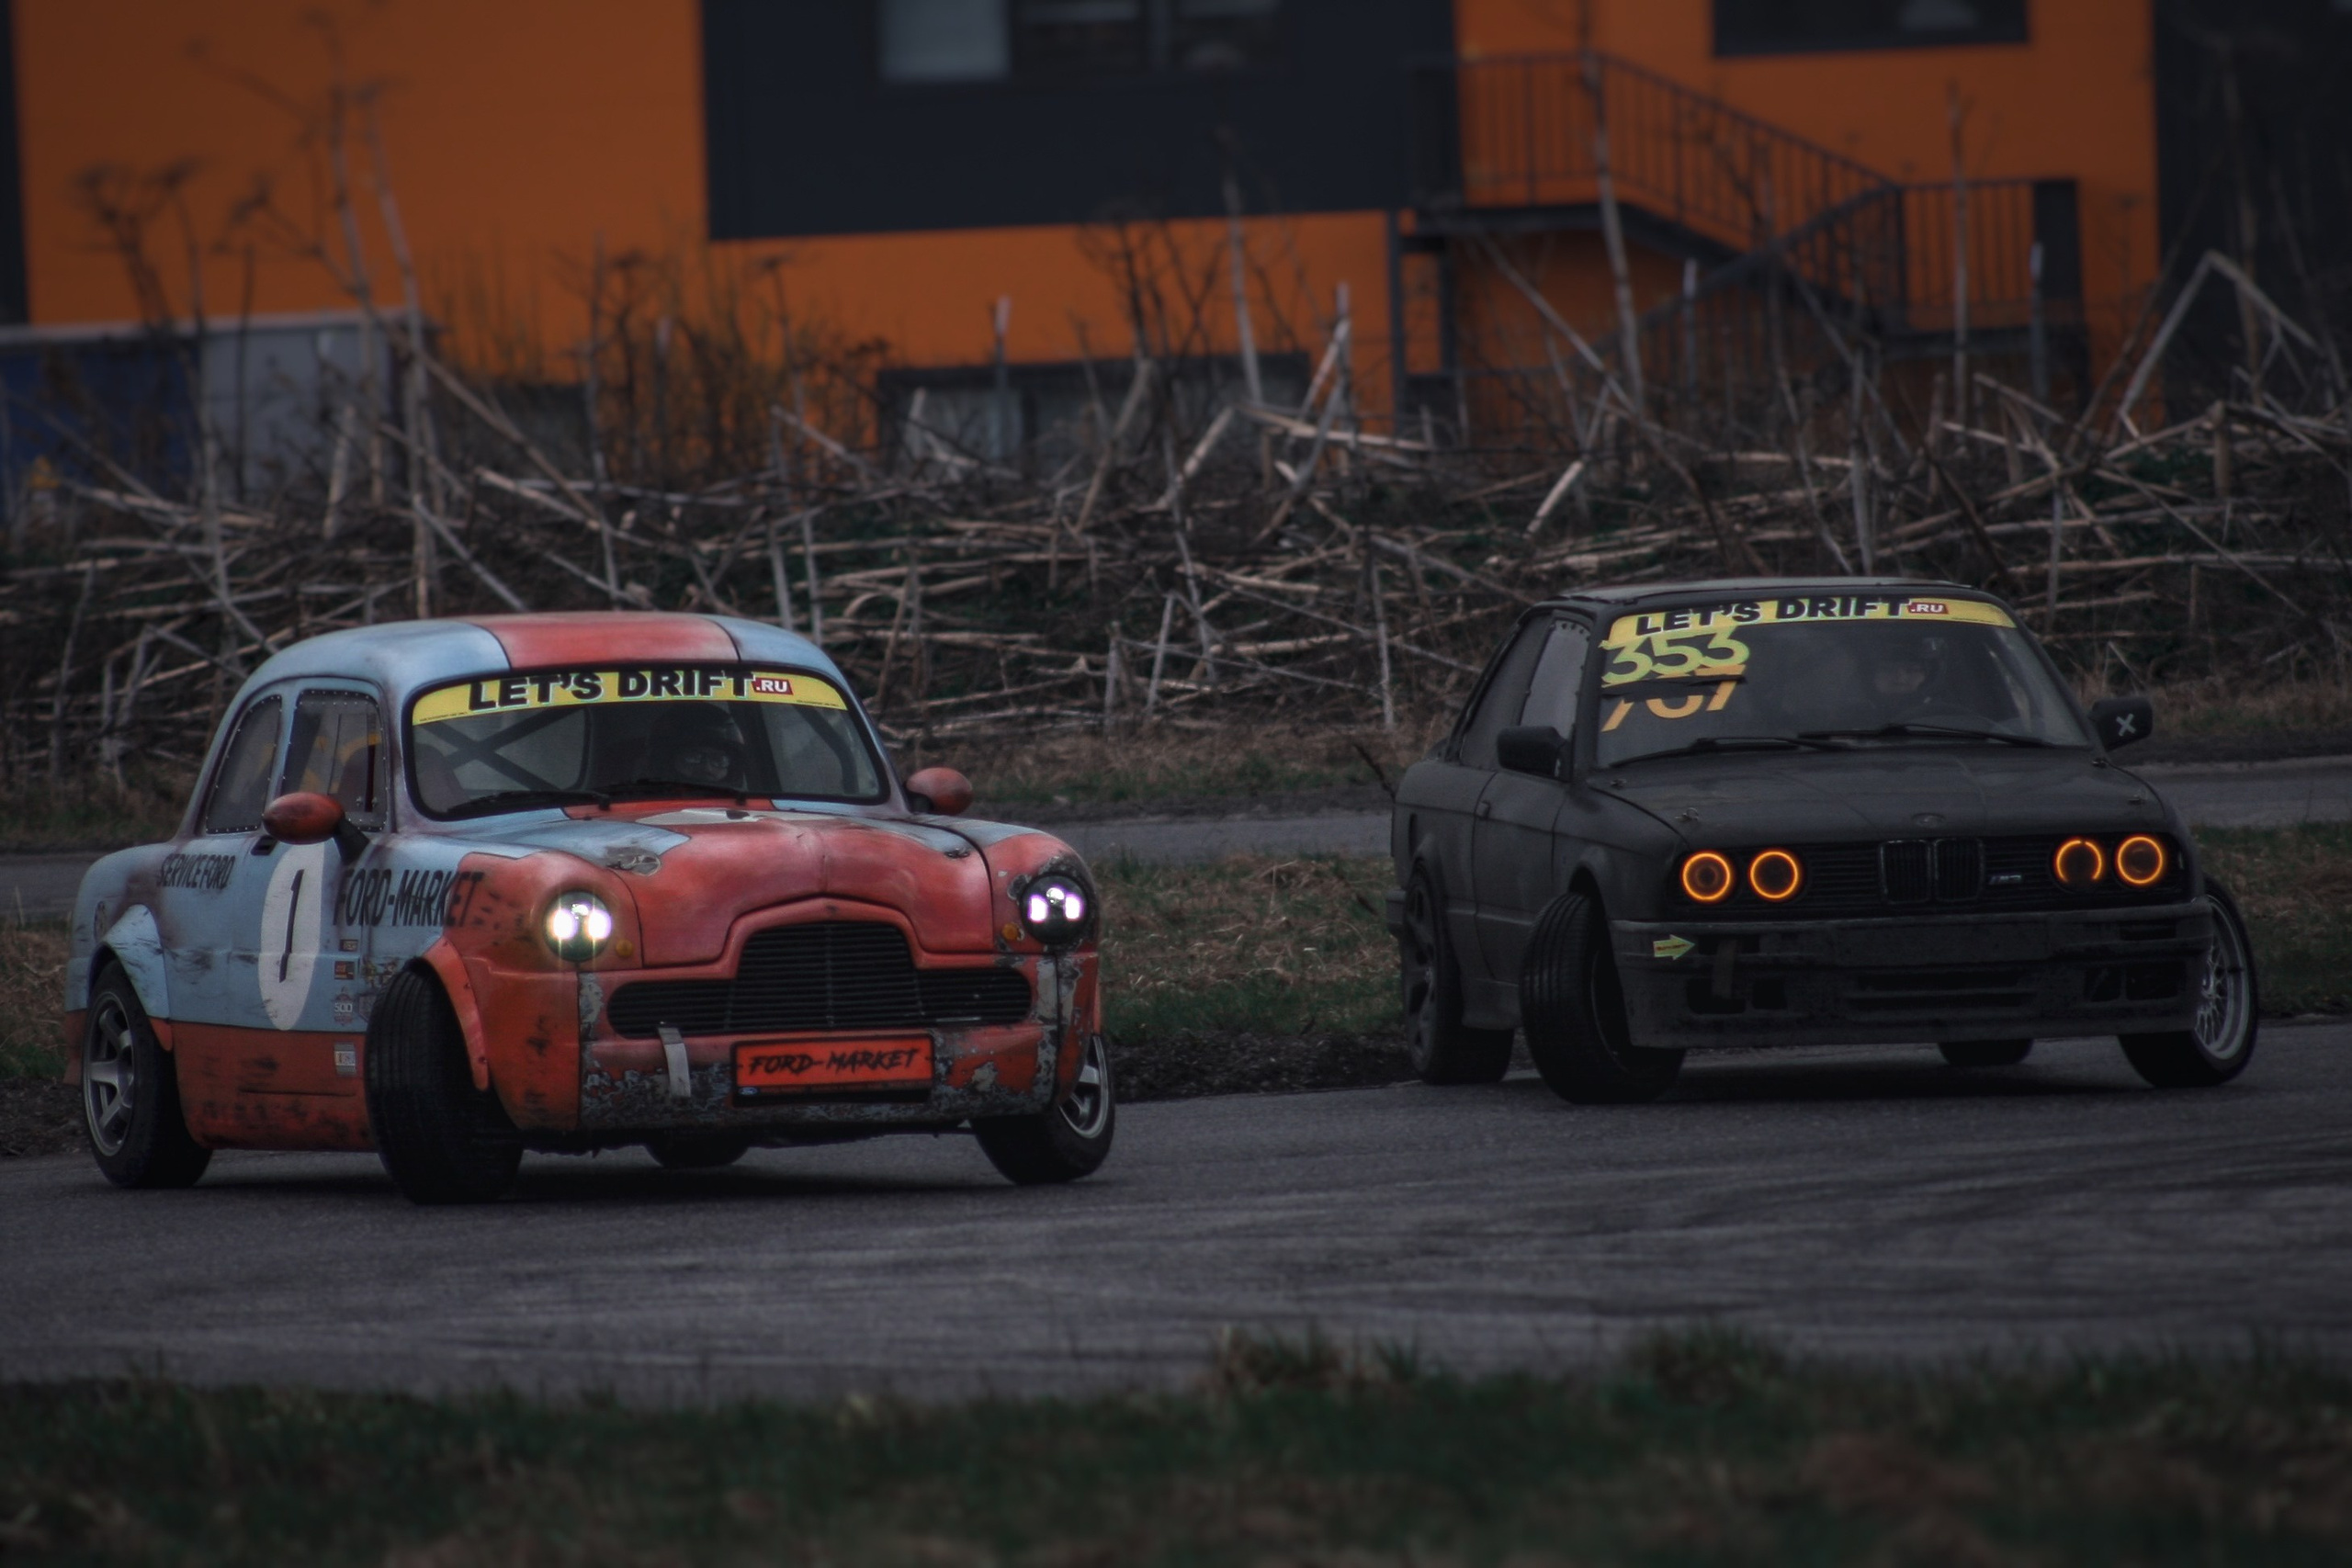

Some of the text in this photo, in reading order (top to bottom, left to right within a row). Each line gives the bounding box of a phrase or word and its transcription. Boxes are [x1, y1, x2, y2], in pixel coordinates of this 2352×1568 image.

[1636, 601, 1763, 637] LET'S
[1776, 596, 1912, 621] DRIFT
[1598, 624, 1751, 688] 353
[469, 671, 604, 711] LET'S
[617, 670, 755, 700] DRIFT
[332, 868, 484, 927] FORD-MARKET
[278, 868, 304, 983] 1
[748, 1048, 920, 1076] FORD-MARKET
